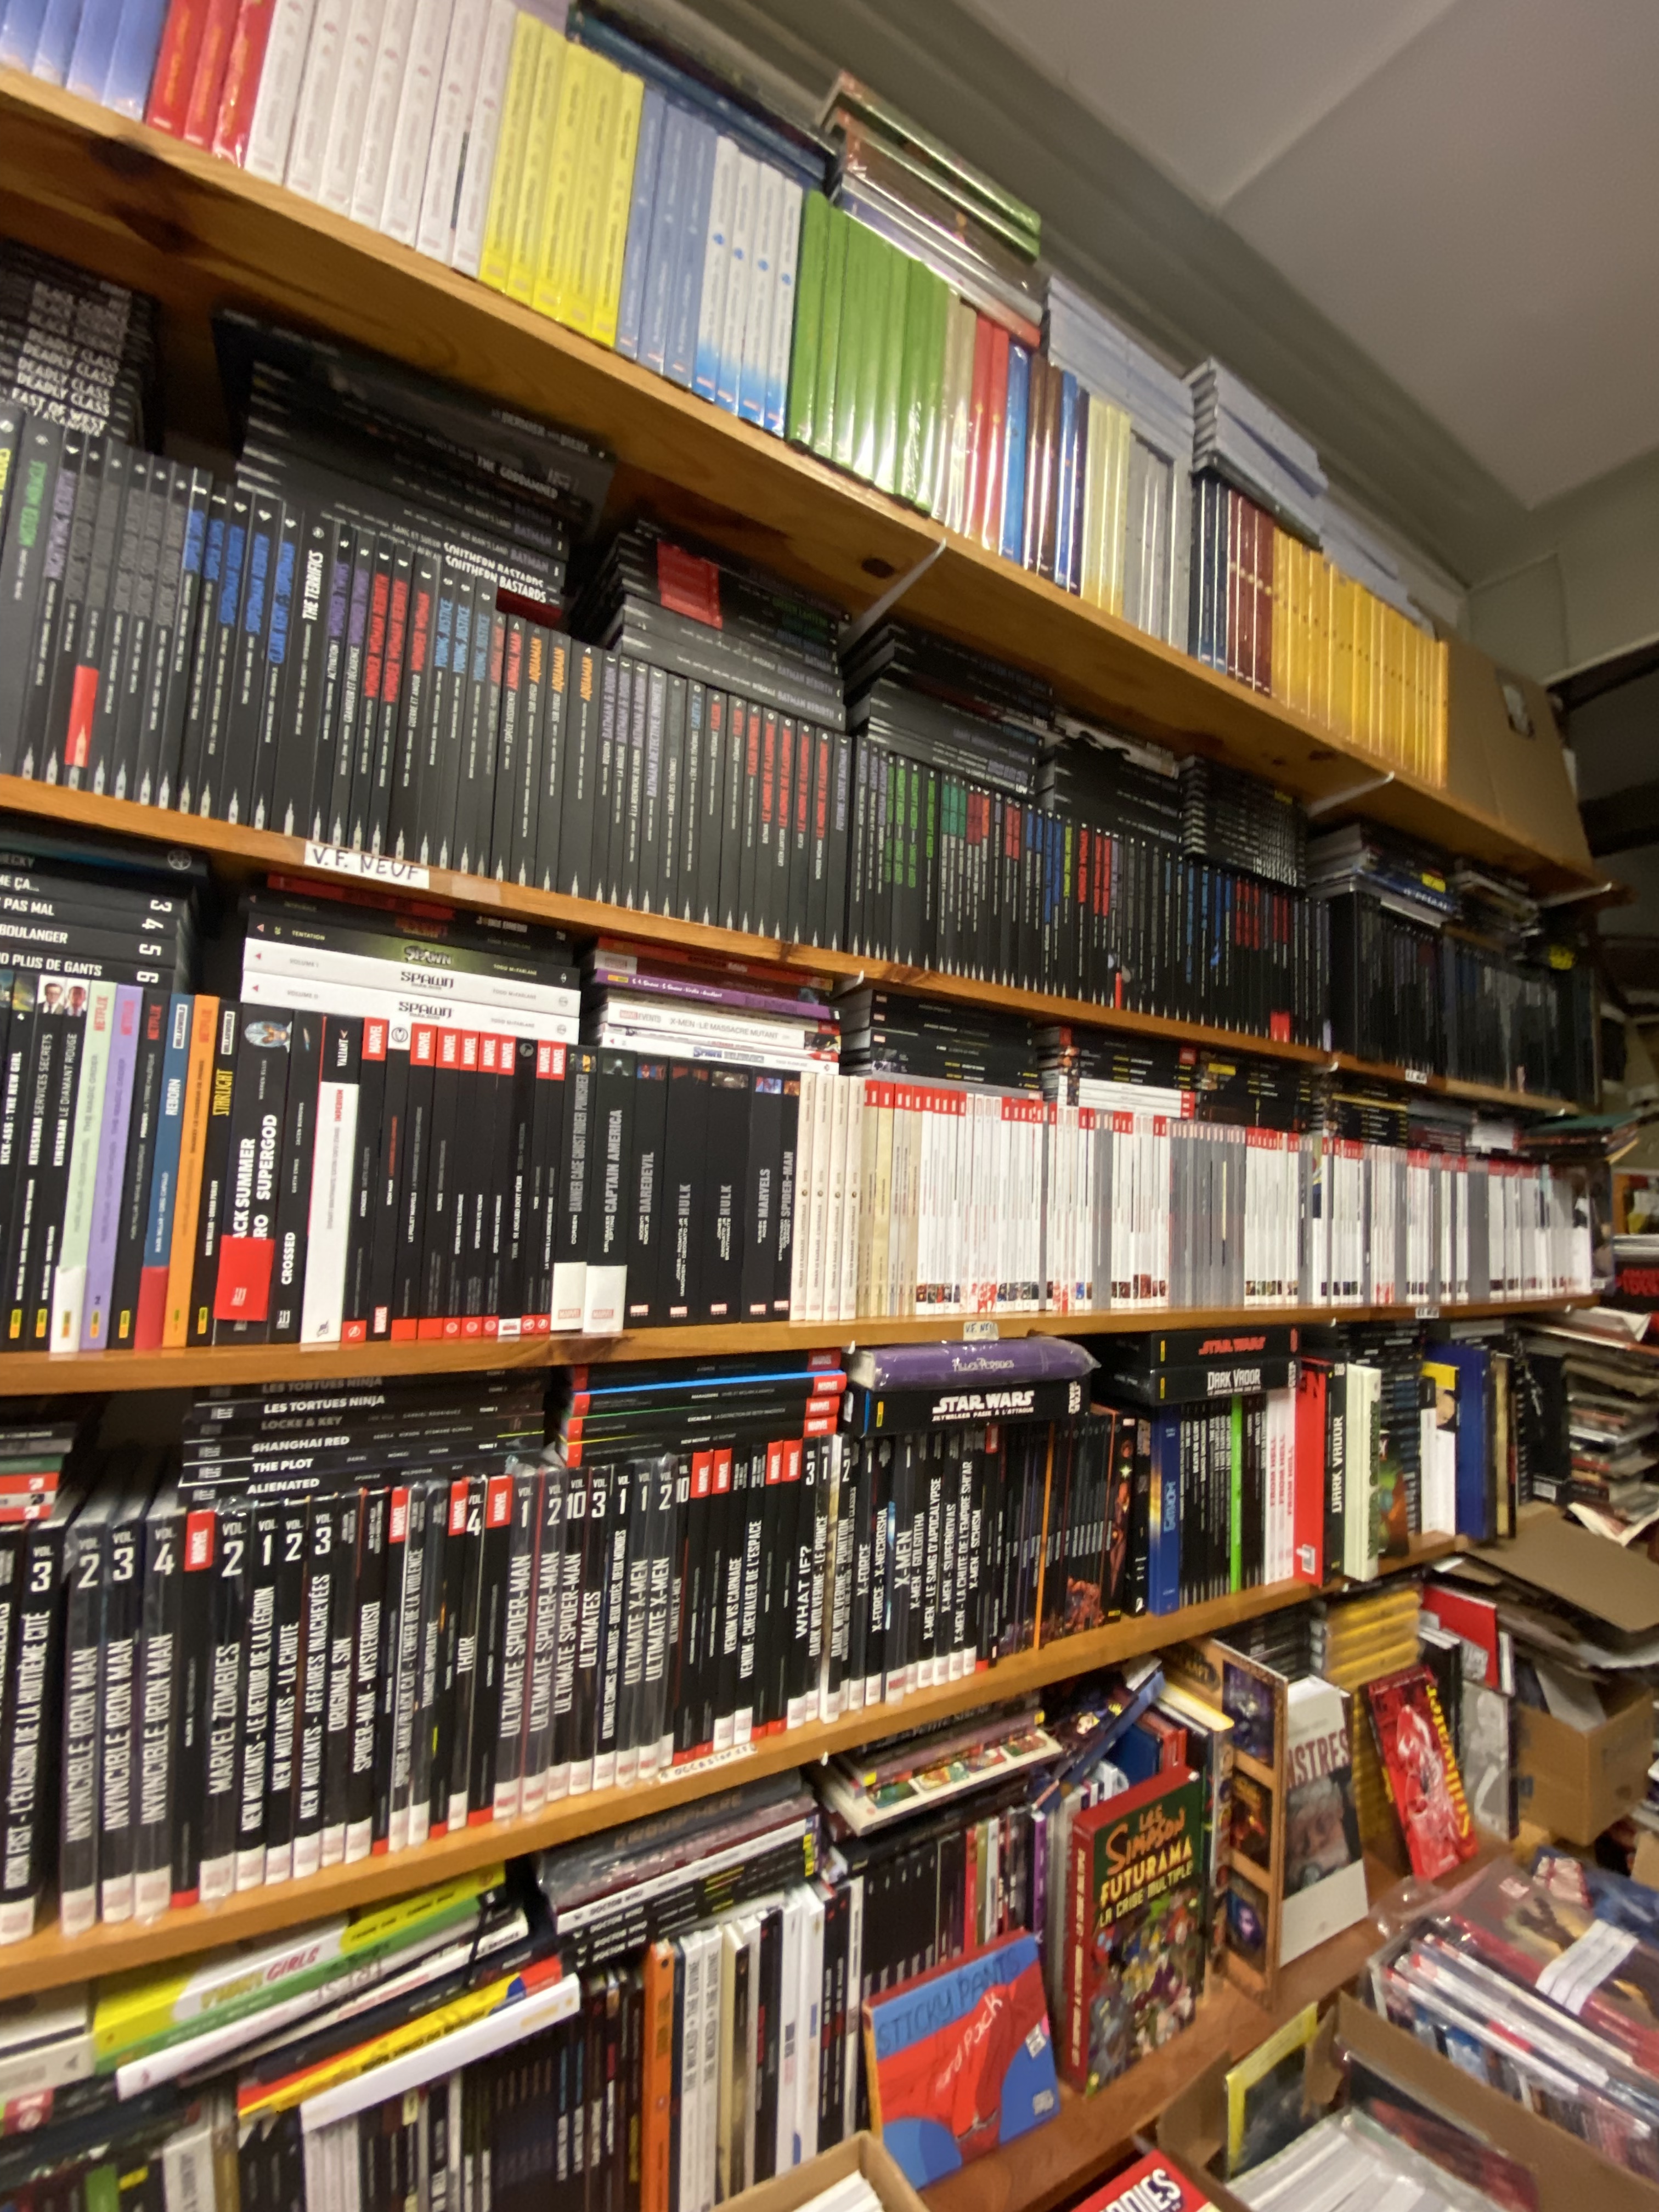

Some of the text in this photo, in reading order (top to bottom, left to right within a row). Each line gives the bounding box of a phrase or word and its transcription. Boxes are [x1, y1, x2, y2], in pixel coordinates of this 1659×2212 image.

[302, 550, 323, 620] THE TERRIFICS
[499, 576, 546, 603] BASTARDS
[360, 855, 421, 879] NEUF
[4, 898, 55, 916] PAS MAL
[142, 918, 164, 929] 4
[150, 899, 172, 912] 3
[0, 924, 69, 944] BOULANGER
[139, 943, 161, 956] 5
[292, 930, 325, 941] TENTATION
[12, 953, 43, 969] PLUS
[46, 959, 61, 971] DE
[64, 961, 103, 977] GANTS
[401, 971, 454, 989] SPAWN
[399, 1001, 452, 1018] SPAWN
[670, 1019, 695, 1028] X-MEN
[710, 1023, 749, 1034] MASSACRE
[751, 1030, 778, 1039] MUTANT
[39, 1034, 53, 1072] SECRETS
[65, 1034, 77, 1063] ROUGE
[337, 1039, 348, 1067] VALIANT
[443, 1034, 456, 1063] MARVEL
[463, 1037, 476, 1065] MARVEL
[483, 1039, 495, 1067] MARVEL
[501, 1042, 514, 1069] MARVEL
[539, 1046, 550, 1073] MARVEL
[553, 1047, 565, 1075] MARVEL
[33, 1074, 48, 1116] SERVICES
[60, 1064, 74, 1104] DIAMANT
[166, 1079, 182, 1115] REBORN
[59, 1107, 69, 1117] LE
[335, 1089, 343, 1122] IMPERIUM
[257, 1114, 277, 1200] SUPERGOD
[605, 1110, 622, 1212] CAPTAIN AMERICA
[639, 1152, 654, 1212] DAREDEVIL
[678, 1184, 691, 1215] HULK
[720, 1184, 732, 1215] HULK
[758, 1169, 770, 1217] MARVELS
[781, 1152, 793, 1217] SPIDER-MAN
[282, 1232, 295, 1285] CROSSED
[1199, 1340, 1232, 1355] STAR
[1207, 1368, 1261, 1390] DARK VADOR
[261, 1418, 303, 1430] LOCKE
[318, 1415, 342, 1426] KEY
[264, 1395, 385, 1414] LES TORTUES NINJA
[933, 1390, 1035, 1414] STAR WARS
[252, 1436, 349, 1453] SHANGHAI RED
[1331, 1415, 1343, 1513] DARK VADOR
[247, 1478, 320, 1495] ALIENATED
[253, 1459, 313, 1473] THE PLOT
[857, 1544, 871, 1596] X-FORCE
[872, 1508, 888, 1632] X-FORCE X-NECROSHA
[895, 1530, 912, 1589] X-MEN
[910, 1512, 925, 1610] X-MEN GOLGOTHA
[924, 1477, 941, 1640] X-MEN LE SANG D'APOCALYPSE
[941, 1503, 956, 1613] X-MEN SUPERNOVAS
[969, 1510, 981, 1589] X-MEN SCHISM
[724, 1557, 742, 1654] VENOM VS CARNAGE
[740, 1520, 762, 1679] VENOM CHEVALIER DE L'ESPACE
[795, 1545, 812, 1639] WHAT IF?
[809, 1515, 827, 1656] DARK WOLVERINE LE PRINCE
[831, 1519, 849, 1657] DARK WOLVERINE PUNITION
[554, 1553, 581, 1714] ULTIMATE SPIDER-MAN
[579, 1591, 601, 1668] ULTIMATES
[625, 1559, 648, 1685] ULTIMATE X-MEN
[646, 1557, 669, 1681] ULTIMATE X-MEN
[457, 1636, 475, 1674] THOR
[500, 1554, 532, 1738] ULTIMATE SPIDER-MAN
[529, 1551, 560, 1732] ULTIMATE SPIDER-MAN
[300, 1575, 330, 1819] NEW MUTANTS AFFAIRES INACHEVÉES
[329, 1638, 352, 1731] ORIGINAL SIN
[353, 1602, 380, 1773] SPIDER-MAN MYSTERIOSO
[208, 1643, 240, 1795] MARVEL ZOMBIES
[241, 1586, 274, 1832] NEW MUTANTS LE RETOUR DE LA LÉGION
[272, 1622, 299, 1791] NEW MUTANTS LA CHUTE
[65, 1647, 98, 1844] INVINCIBLE IRON MAN
[104, 1638, 133, 1832] INVINCIBLE IRON MAN
[141, 1633, 173, 1825] INVINCIBLE IRON MAN
[1100, 1835, 1192, 1908] FUTURAMA
[1100, 1911, 1112, 1927] LA
[877, 1991, 953, 2052] STICKY
[958, 1947, 1020, 2006] PANTS
